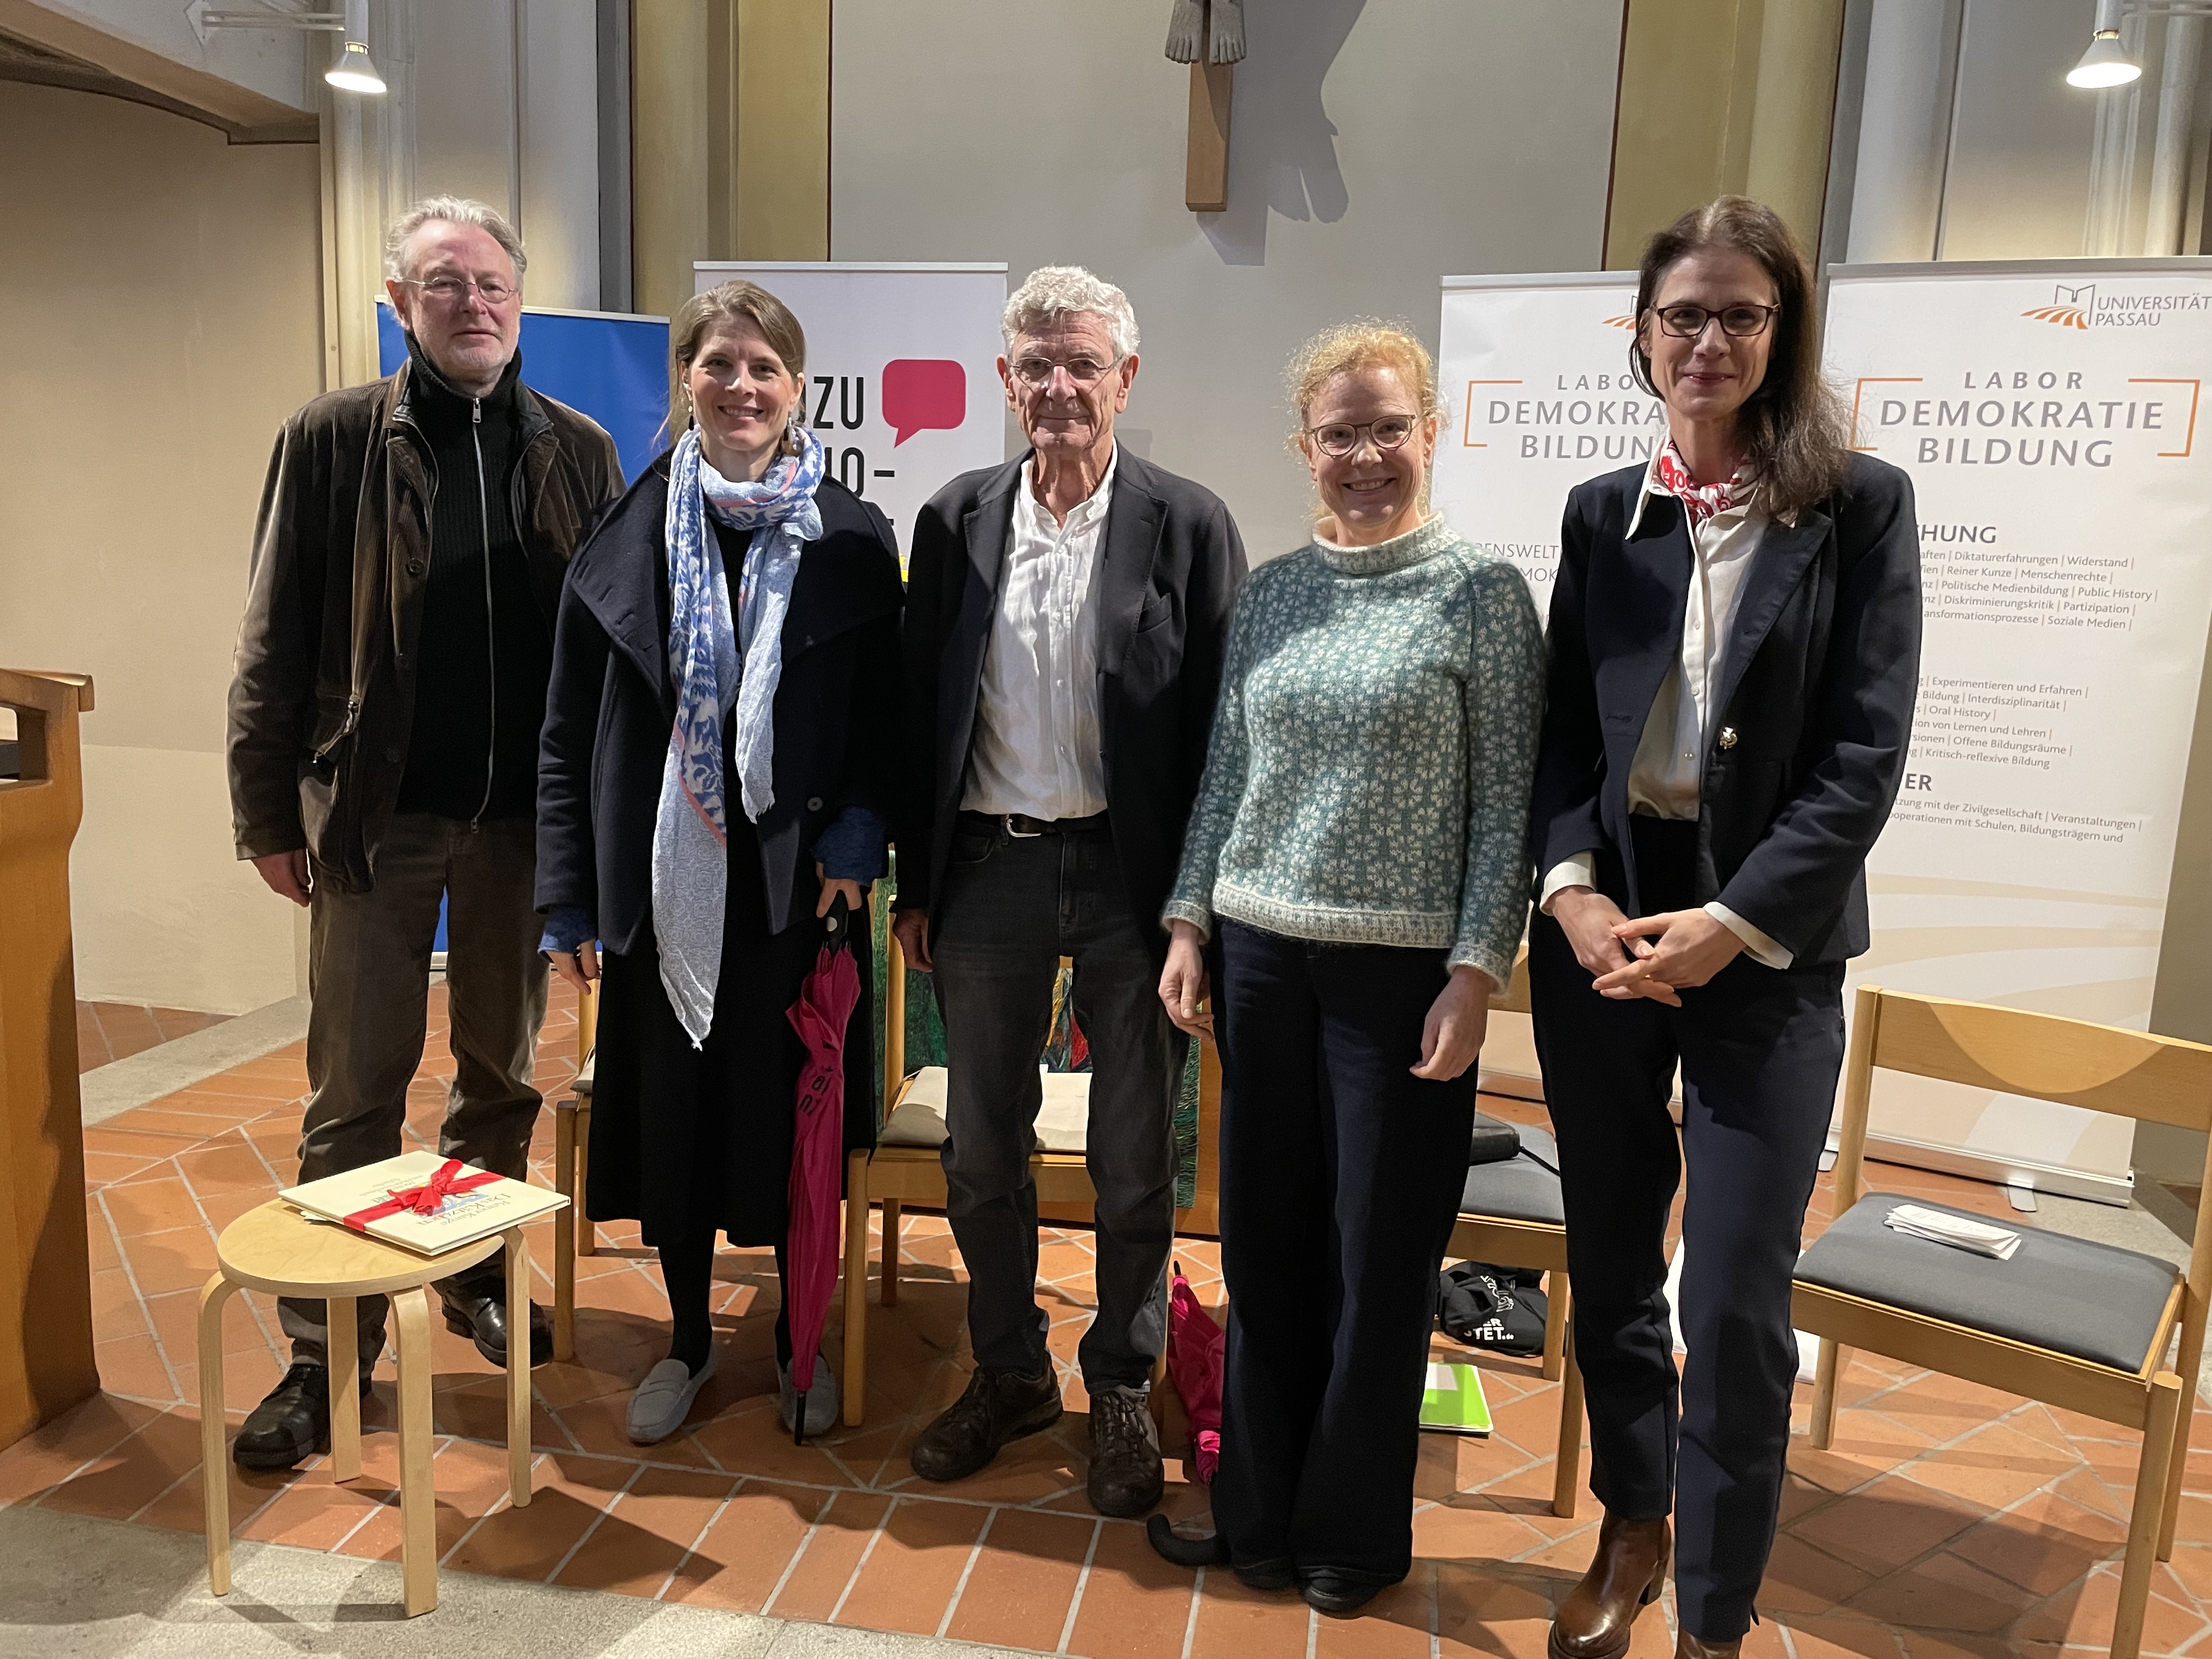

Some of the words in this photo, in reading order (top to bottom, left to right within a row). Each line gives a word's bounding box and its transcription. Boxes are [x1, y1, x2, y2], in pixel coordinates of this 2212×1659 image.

[2097, 292, 2212, 310] UNIVERSITÄT
[2095, 312, 2160, 326] PASSAU
[1558, 375, 1634, 391] LABO
[1964, 371, 2083, 390] LABOR
[813, 376, 864, 430] ZU
[1488, 400, 1665, 425] DEMOKRA
[1880, 400, 2163, 430] DEMOKRATIE
[1521, 435, 1654, 460] BILDUN
[1918, 437, 2113, 467] BILDUNG
[1917, 525, 1996, 543] HUNG
[1920, 550, 1945, 560] aften
[1954, 551, 2058, 566] Diktaturerfahrungen
[2068, 556, 2128, 568] Widerstand
[1947, 566, 1978, 576] Reiner
[1982, 567, 2012, 578] Kunze
[2021, 569, 2107, 583] Menschenrechte
[1942, 580, 1989, 591] Politische
[1993, 583, 2069, 597] Medienbildung
[2078, 586, 2110, 599] Public
[2113, 589, 2153, 602] History
[1944, 595, 2054, 611] Diskriminierungskritik
[2063, 601, 2129, 615] Partizipation
[1924, 609, 2038, 625] ansformationsprozesse
[2047, 615, 2084, 627] Soziale
[2087, 618, 2126, 629] Medien
[1932, 676, 2013, 691] Experimentieren
[2017, 684, 2036, 693] und
[2039, 684, 2082, 696] Erfahren
[1922, 690, 1960, 704] Bildung
[1968, 693, 2060, 710] Interdisziplinarität
[1929, 705, 1950, 715] Oral
[1954, 707, 1991, 720] History
[1932, 721, 1950, 730] von
[1953, 721, 1987, 733] Lernen
[1990, 725, 2009, 735] und
[2012, 726, 2046, 738] Lehren
[1912, 733, 1945, 744] sionen
[1953, 736, 1988, 748] Offene
[1991, 739, 2066, 755] Bildungsräume
[1926, 749, 2008, 764] Kritisch-reflexive
[2012, 755, 2050, 770] Bildung
[1905, 773, 1932, 792] ER
[1895, 798, 1921, 811] tzung
[1924, 800, 1941, 810] mit
[1944, 802, 1960, 811] der
[1962, 803, 2043, 821] Zivilgesellschaft
[2051, 812, 2136, 831] Veranstaltungen
[1955, 817, 1972, 827] mit
[1975, 819, 2017, 833] Schulen,
[2019, 823, 2101, 842] Bildungsträgern
[2103, 833, 2124, 843] und
